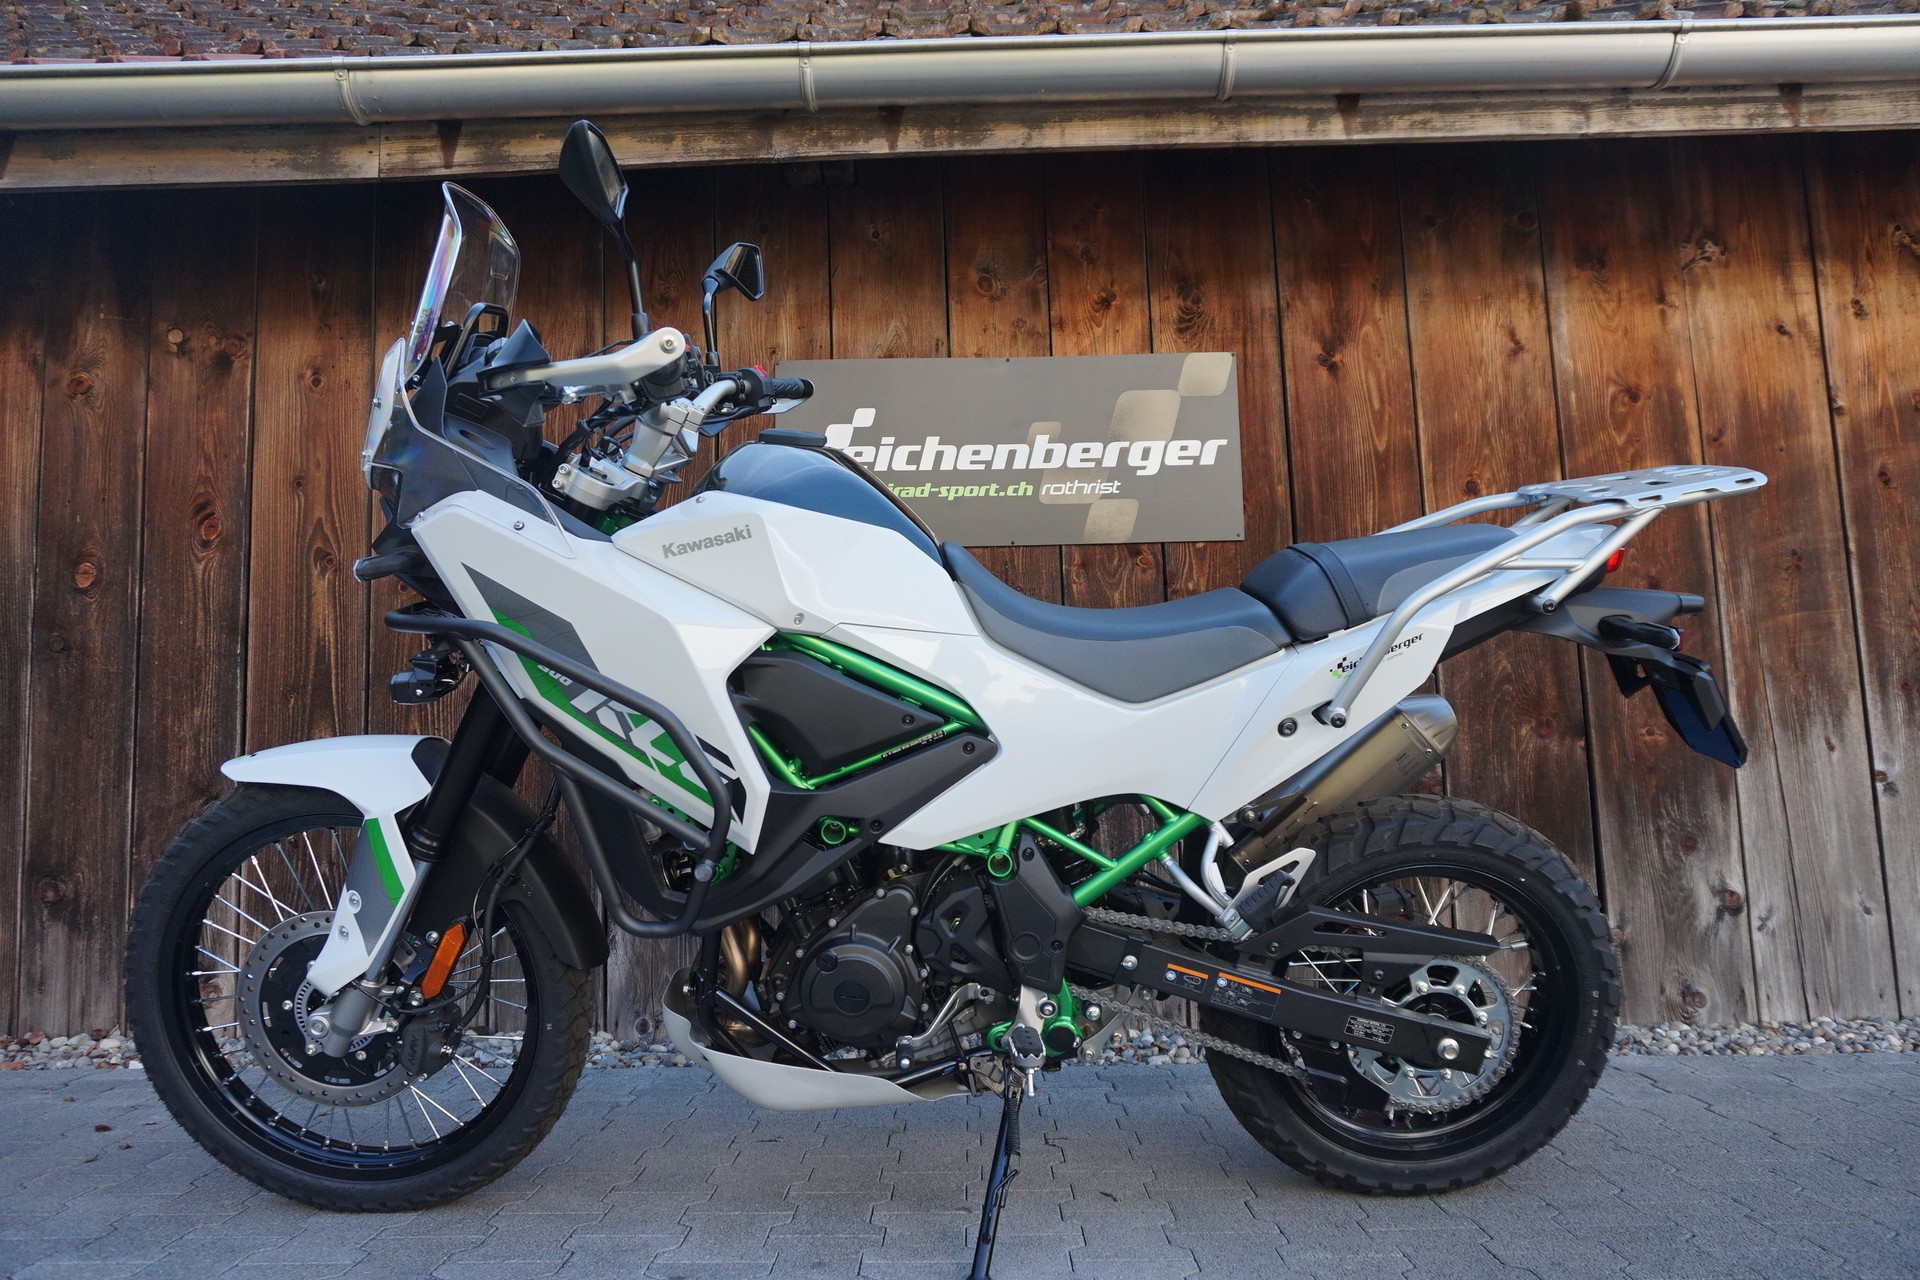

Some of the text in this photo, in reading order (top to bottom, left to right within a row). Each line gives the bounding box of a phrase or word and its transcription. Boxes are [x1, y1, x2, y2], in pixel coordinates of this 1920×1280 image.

[843, 434, 1228, 476] eichenberger
[887, 479, 1121, 501] irad-sport.ch rothrist
[662, 524, 752, 559] Kawasaki
